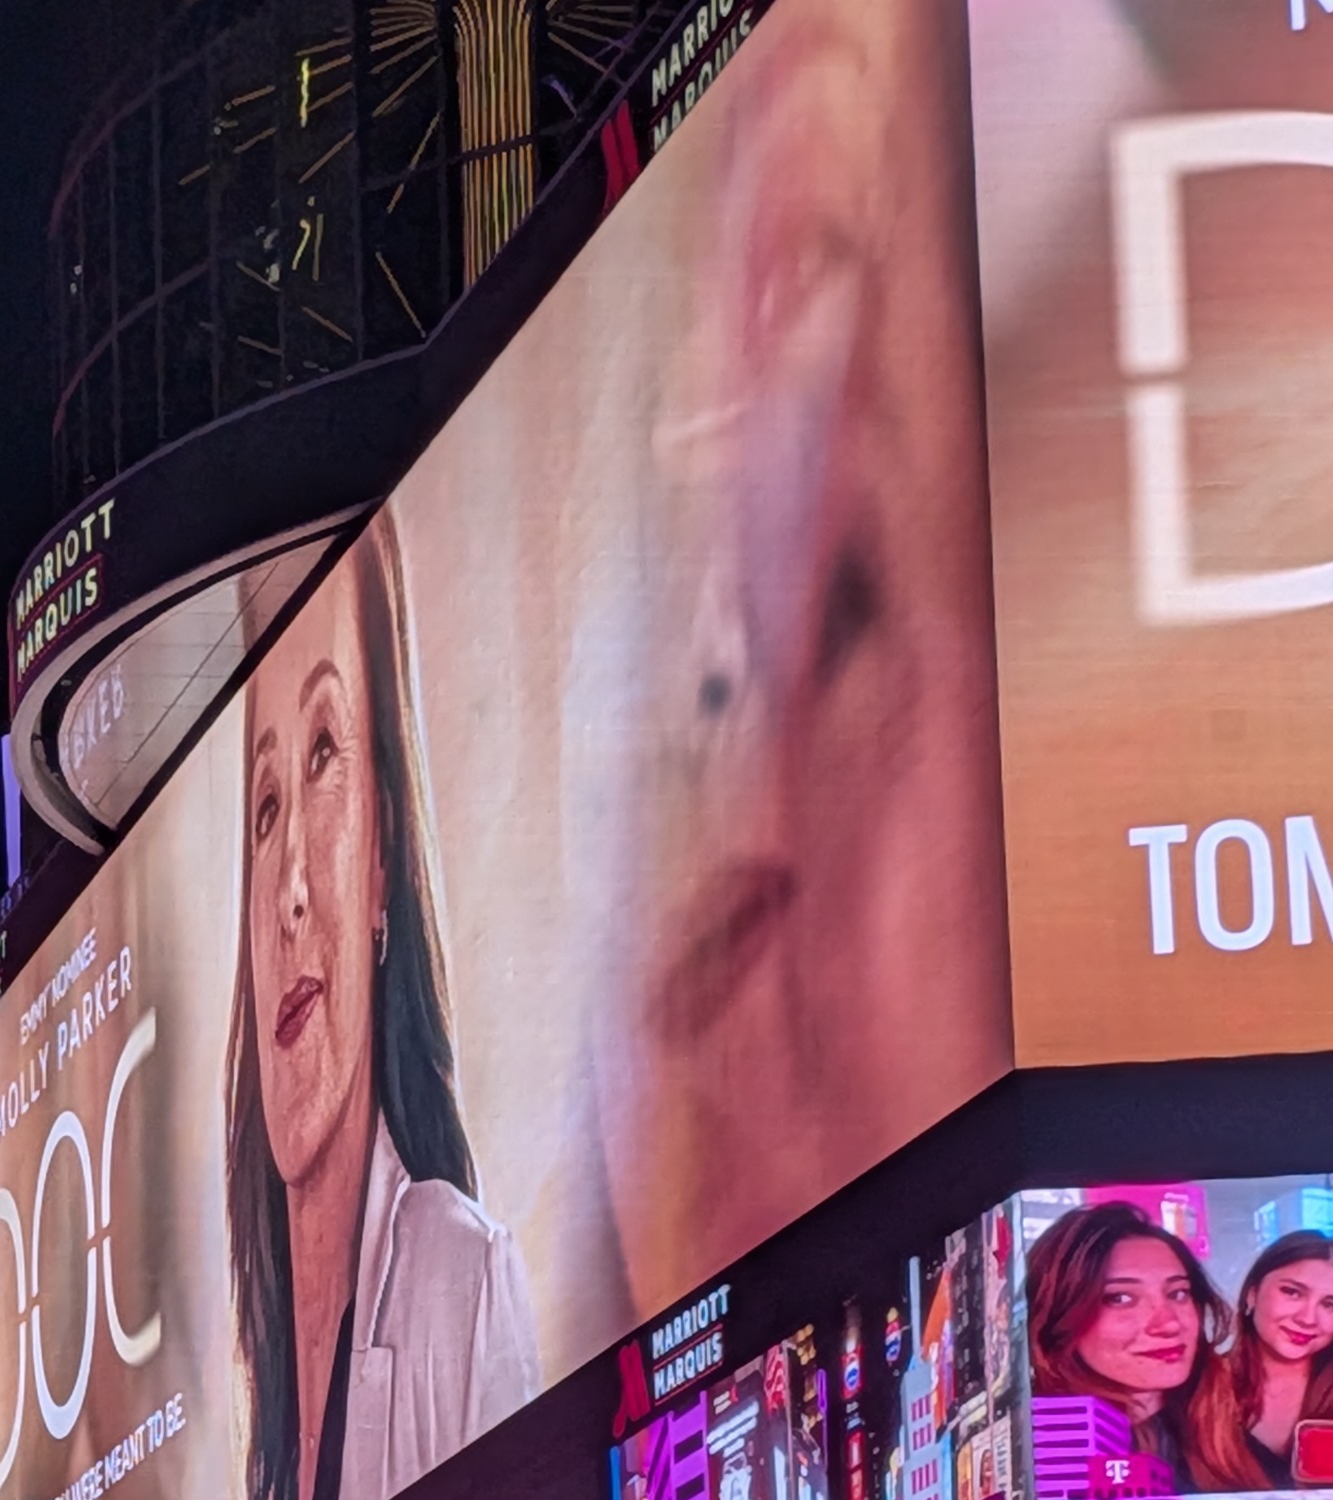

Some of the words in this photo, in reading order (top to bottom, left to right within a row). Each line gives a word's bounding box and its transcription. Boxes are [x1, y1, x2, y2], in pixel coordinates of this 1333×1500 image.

[16, 497, 115, 631] MARRIOTT
[17, 568, 98, 682] MARQUIS
[58, 946, 131, 1071] PARKER
[653, 1284, 731, 1360] MARRIOTT
[654, 1332, 723, 1400] MARQUIS
[105, 1424, 145, 1490] MEANT
[146, 1409, 164, 1454] TO
